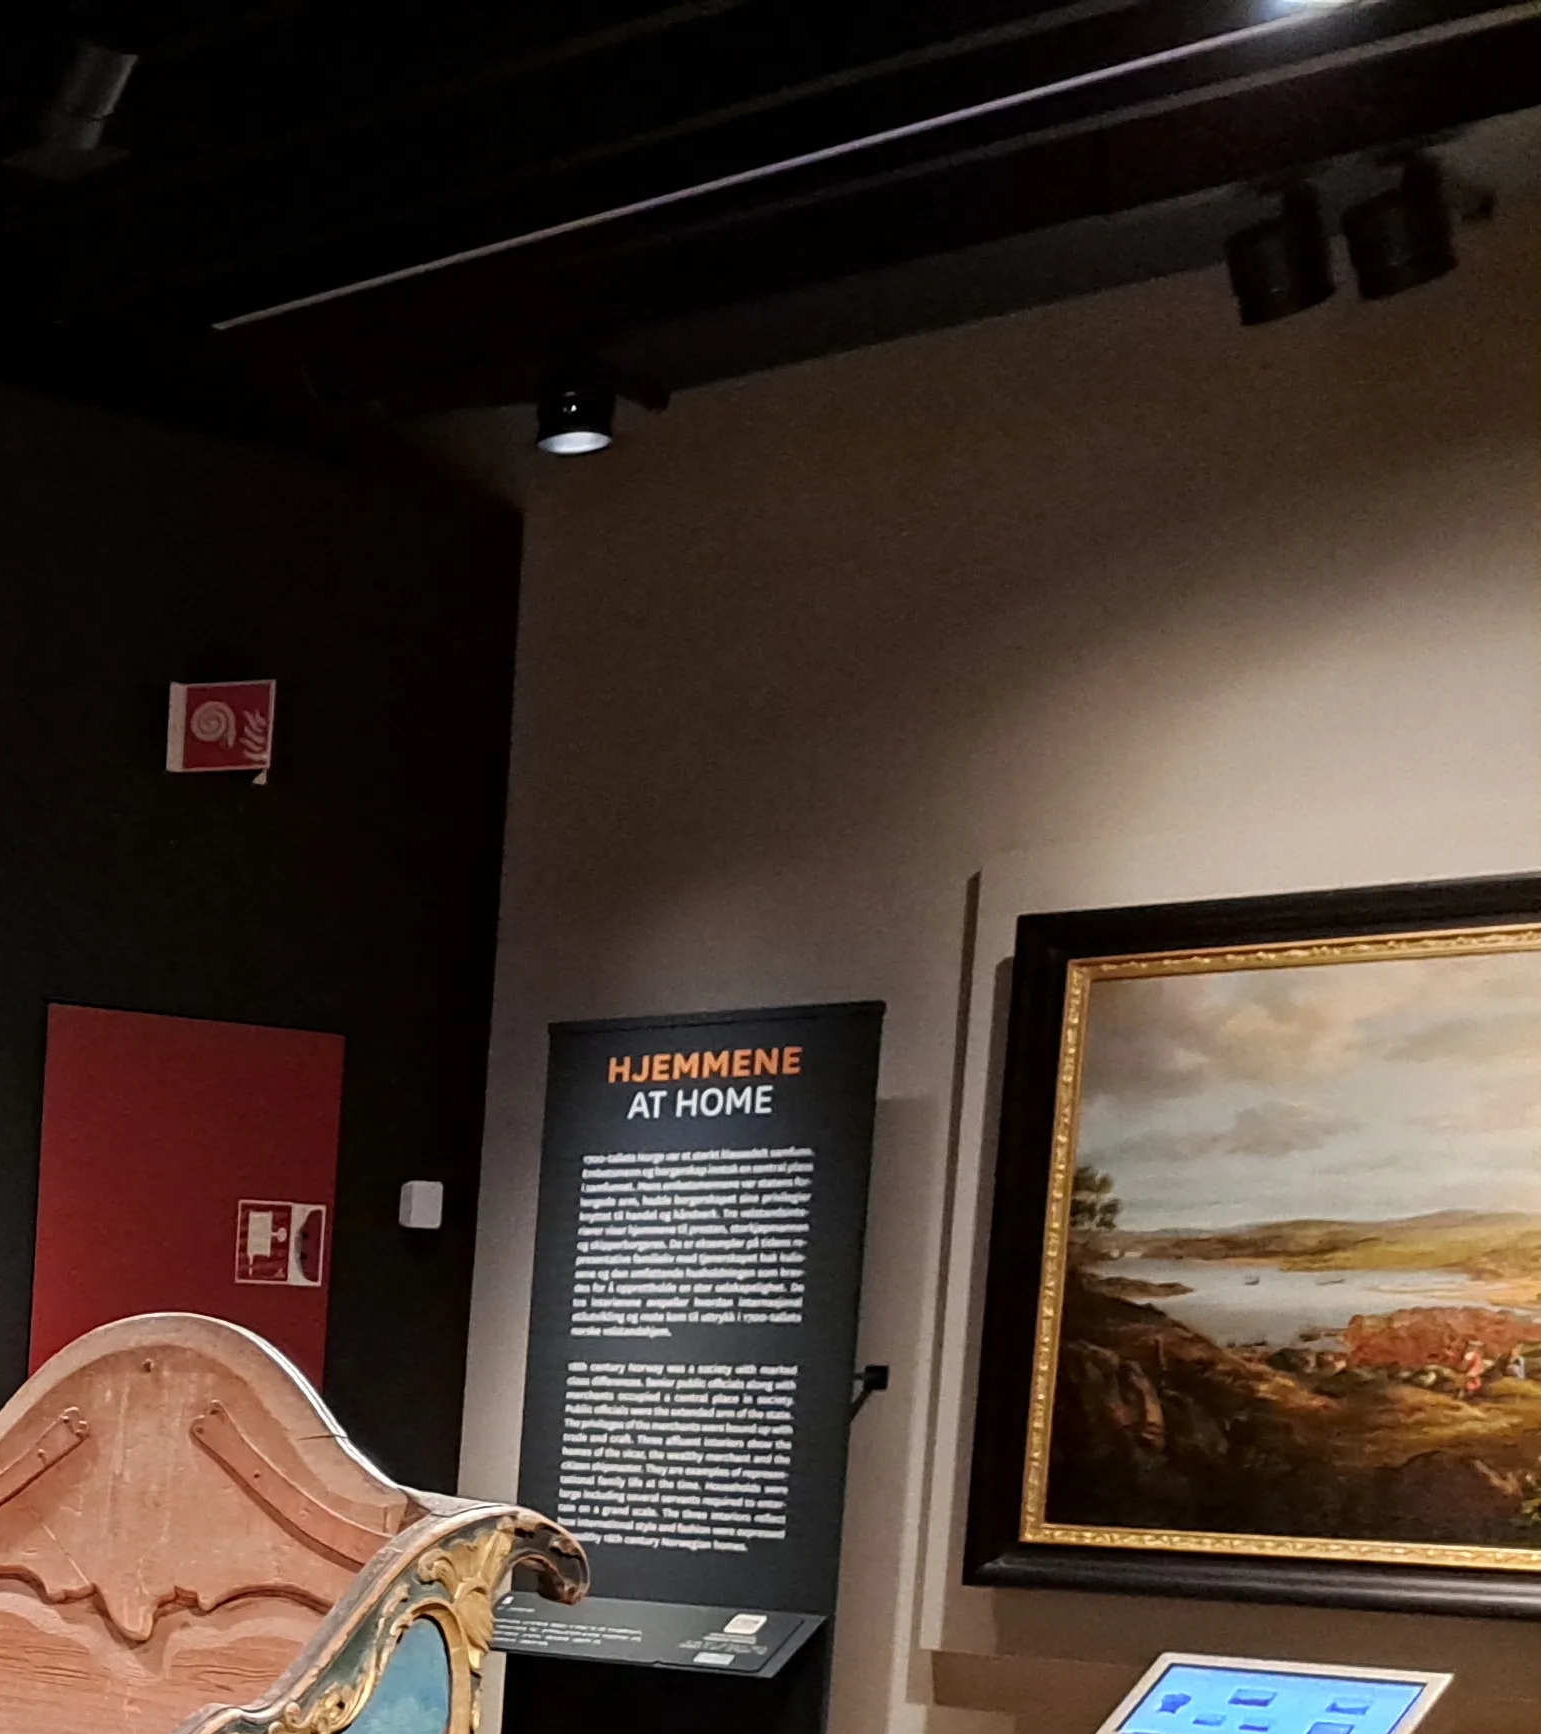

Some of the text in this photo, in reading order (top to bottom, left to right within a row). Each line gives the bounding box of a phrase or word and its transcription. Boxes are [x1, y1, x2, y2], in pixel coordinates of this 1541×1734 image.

[607, 1046, 803, 1084] HJEMMENE
[626, 1085, 774, 1120] AT HOME
